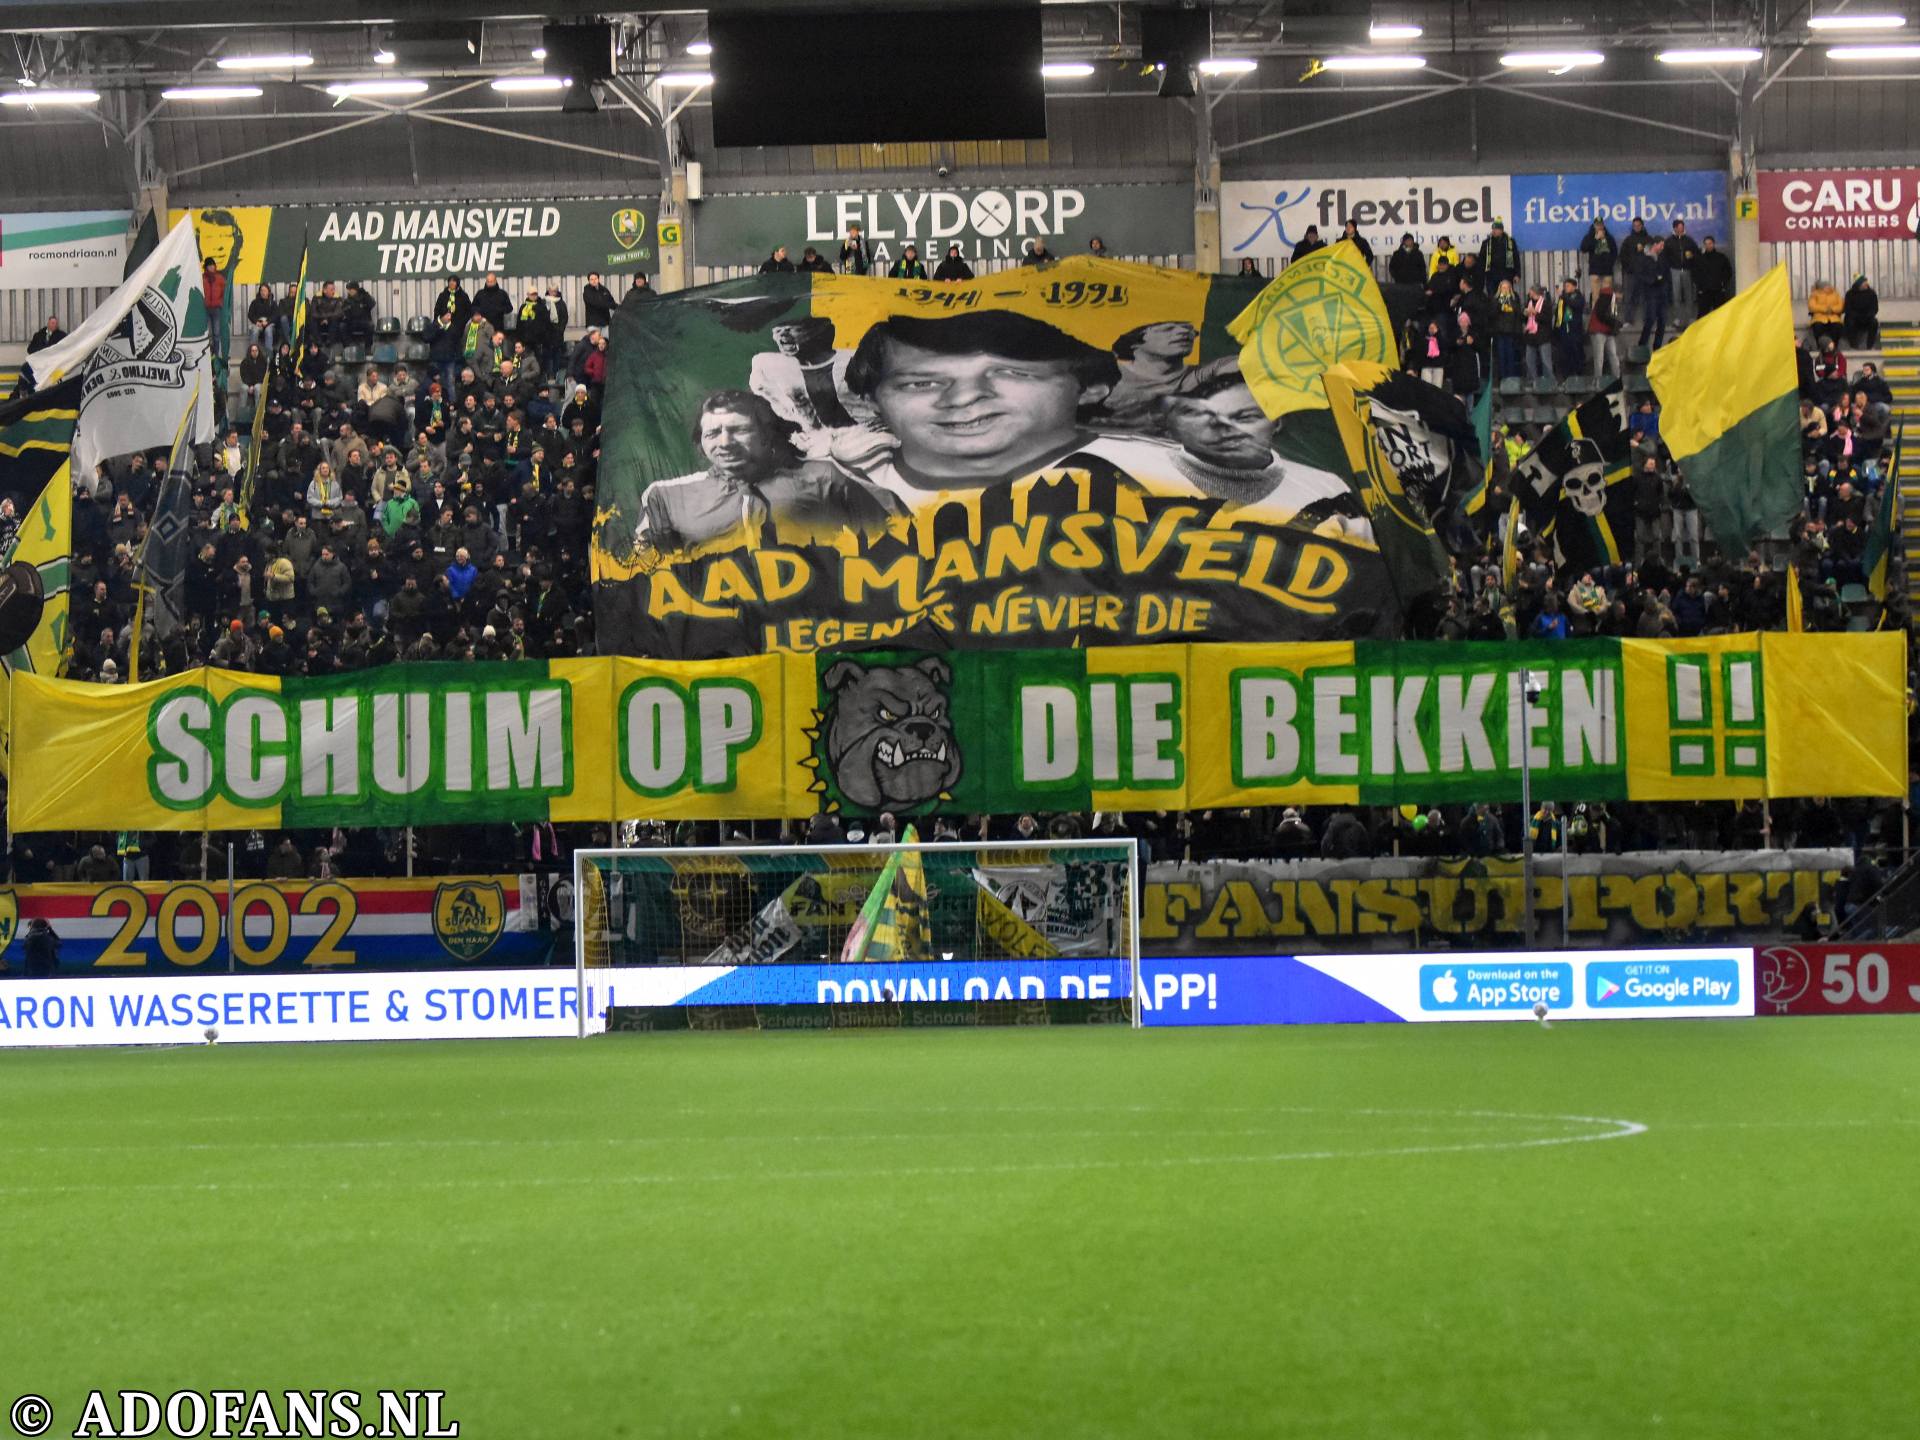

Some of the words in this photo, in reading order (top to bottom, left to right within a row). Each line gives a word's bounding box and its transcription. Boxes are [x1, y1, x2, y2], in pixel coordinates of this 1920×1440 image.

[1316, 186, 1495, 227] flexibel
[1524, 194, 1714, 224] flexibelbv.nl
[1741, 203, 1752, 217] F
[1782, 178, 1901, 213] CARU
[318, 210, 385, 242] AAD
[391, 207, 561, 240] MANSVELD
[806, 189, 1086, 241] LELYDORP
[1785, 214, 1900, 229] CONTAINERS
[662, 226, 678, 242] G
[873, 238, 1036, 261] ATERIN
[28, 248, 117, 260] rocmondriaan.nl
[377, 241, 508, 274] TRIBUNE
[895, 287, 980, 308] 1944
[1043, 281, 1128, 306] 1991
[648, 550, 810, 621] AAD
[842, 506, 1350, 614] MANSVELD
[765, 603, 955, 652] LEGENDS
[970, 586, 1124, 634] NEVER
[1136, 594, 1212, 635] DIE
[153, 684, 566, 803] SCHUIM
[625, 684, 755, 791] OP
[1019, 680, 1178, 783] DIE
[1238, 664, 1619, 780] BEKKEN
[88, 883, 359, 967] 2002
[1467, 969, 1521, 980] Download
[1524, 971, 1538, 979] on
[1541, 968, 1559, 979] the
[1625, 965, 1644, 975] GET
[1644, 965, 1653, 975] IT
[1654, 965, 1670, 975] ON
[1821, 952, 1890, 1004] 50
[1467, 984, 1507, 1007] App
[1509, 982, 1560, 1002] Store
[1625, 977, 1689, 1001] Google
[1692, 977, 1732, 1000] Play
[110, 990, 370, 1027] WASSERETTE
[385, 989, 409, 1023] &
